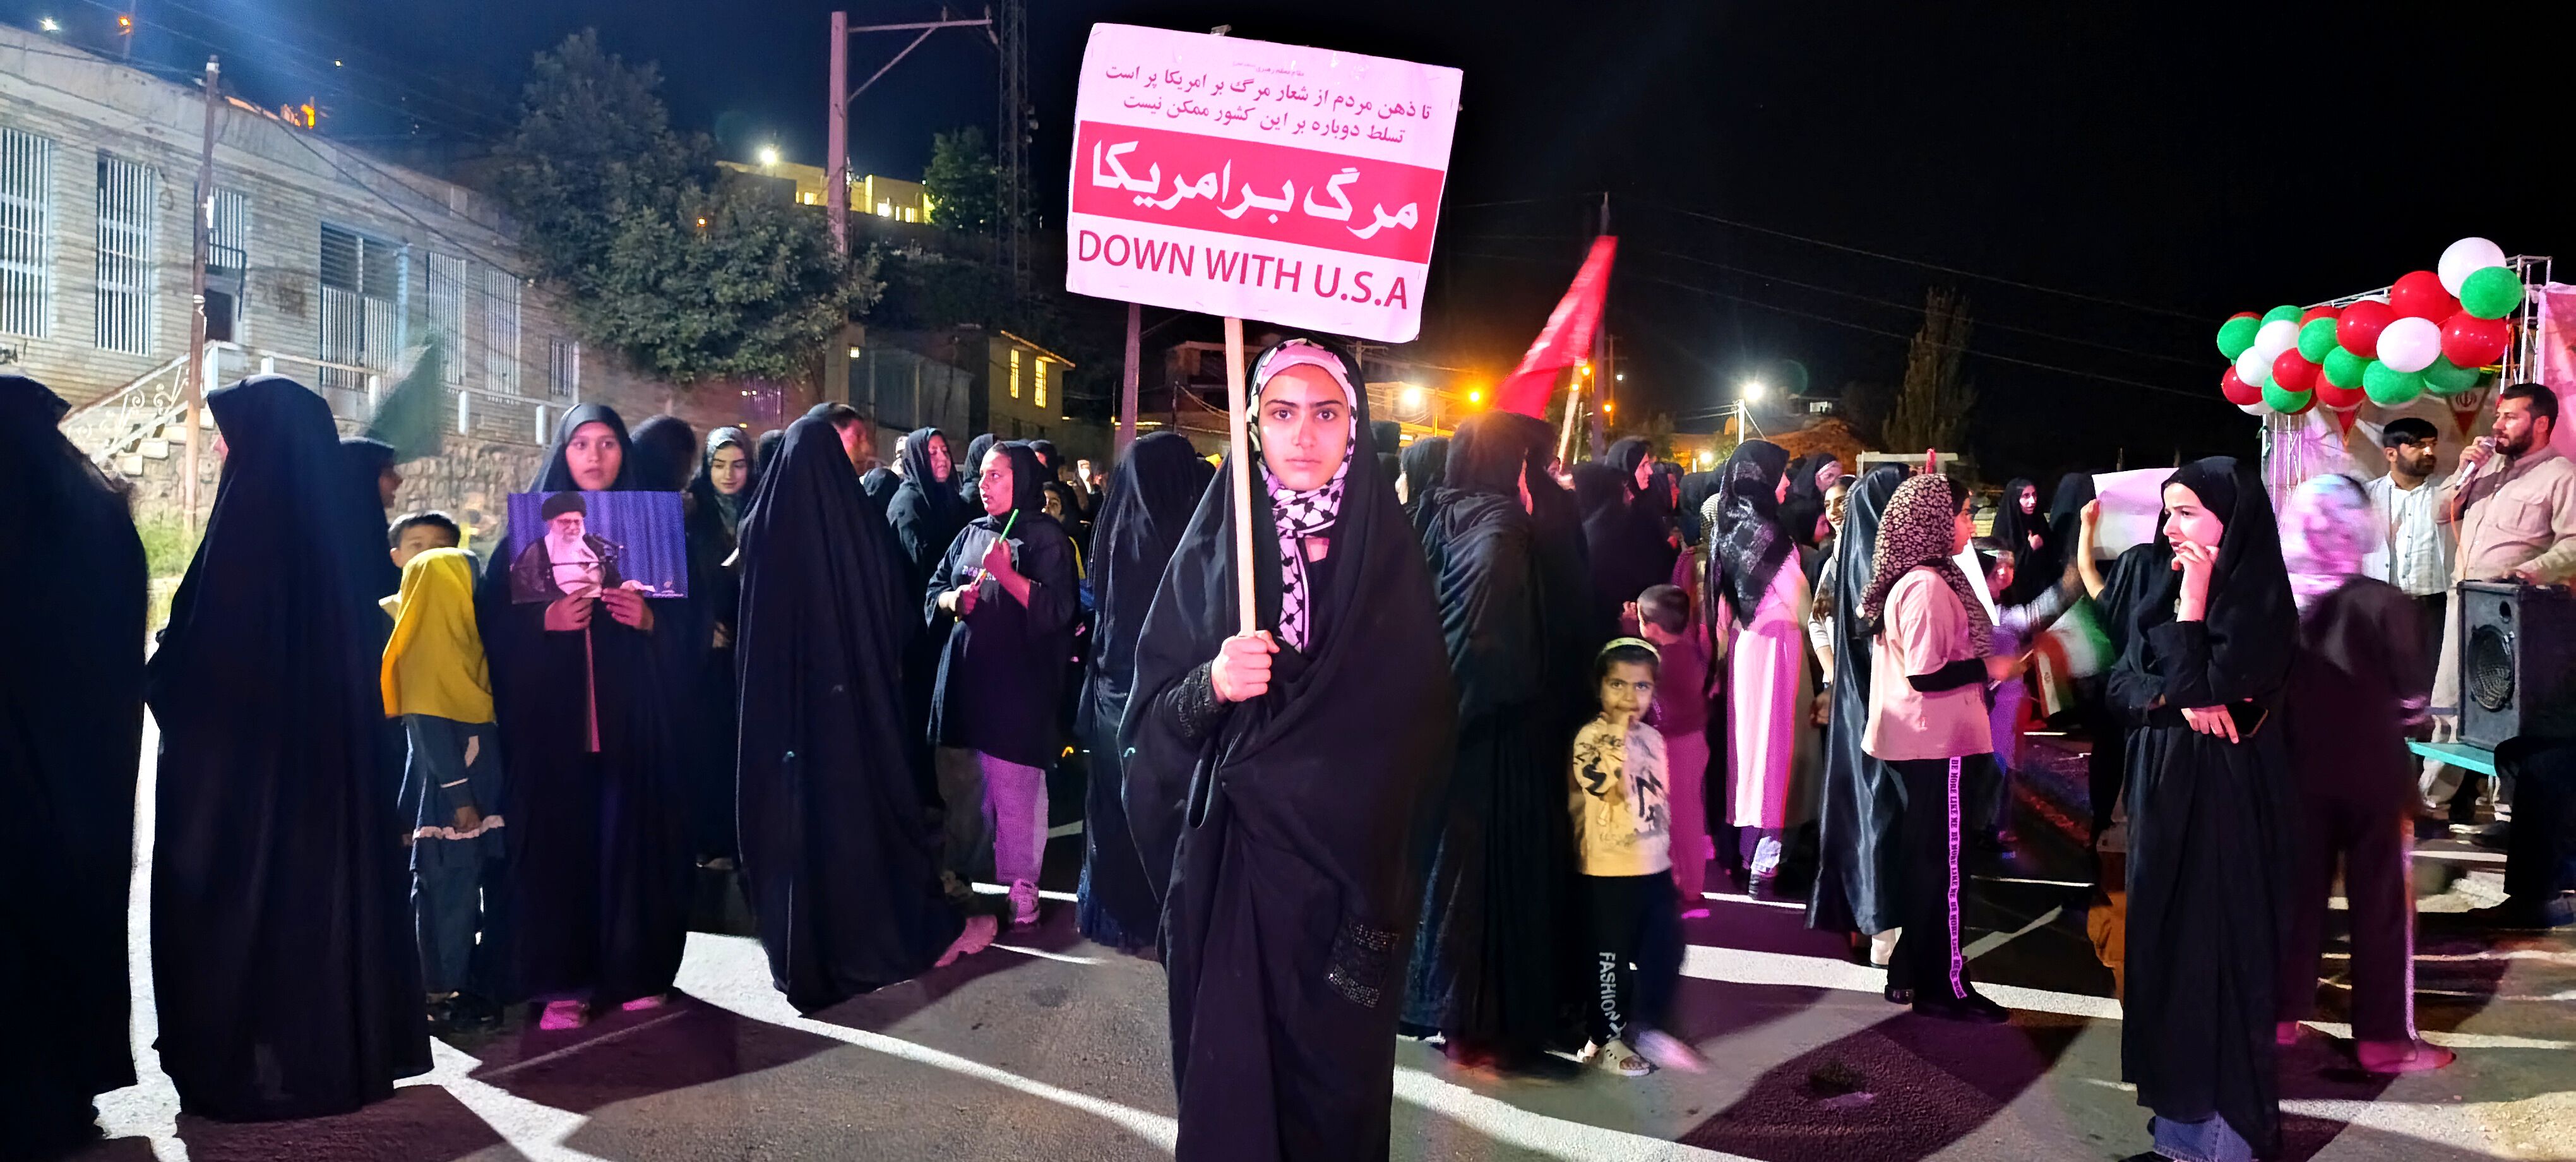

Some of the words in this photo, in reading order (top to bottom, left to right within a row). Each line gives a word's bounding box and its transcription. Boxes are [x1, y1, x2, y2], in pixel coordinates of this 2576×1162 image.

[1106, 65, 1140, 80] است
[1143, 73, 1157, 90] پر
[1164, 69, 1207, 93] امریکا
[1210, 81, 1224, 97] بر
[1229, 79, 1270, 102] مرگ
[1275, 84, 1309, 102] شعار
[1313, 89, 1329, 107] از
[1123, 96, 1162, 115] نیست
[1166, 99, 1210, 119] ممکن
[1333, 95, 1373, 116] مردم
[1378, 101, 1416, 120] ذهن
[1422, 104, 1433, 119] تا
[1213, 105, 1256, 127] کشور
[1260, 112, 1288, 131] این
[1292, 120, 1306, 135] بر
[1311, 118, 1360, 141] دوباره
[1367, 125, 1406, 143] تسلط
[1303, 167, 1419, 239] مرگ
[1078, 229, 1195, 277] DOWN
[1205, 247, 1303, 293] WITH
[1314, 264, 1407, 310] U.S.A
[1950, 796, 1958, 815] LIKE
[1598, 951, 1620, 1021] FASHION
